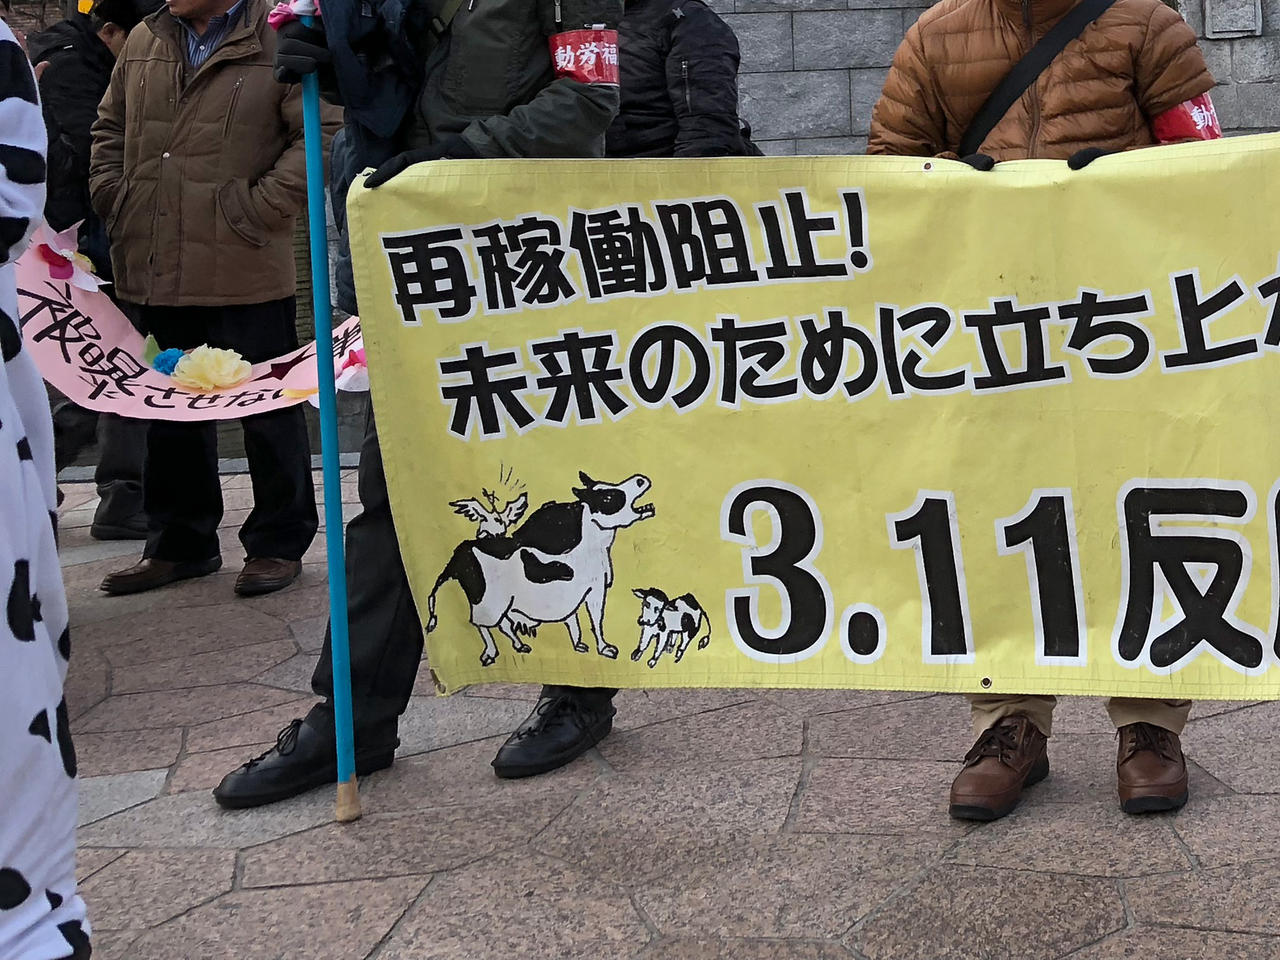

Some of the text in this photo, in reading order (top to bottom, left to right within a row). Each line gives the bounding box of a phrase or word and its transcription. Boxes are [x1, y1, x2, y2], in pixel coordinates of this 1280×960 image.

[384, 190, 870, 324] 再稼働阻止!
